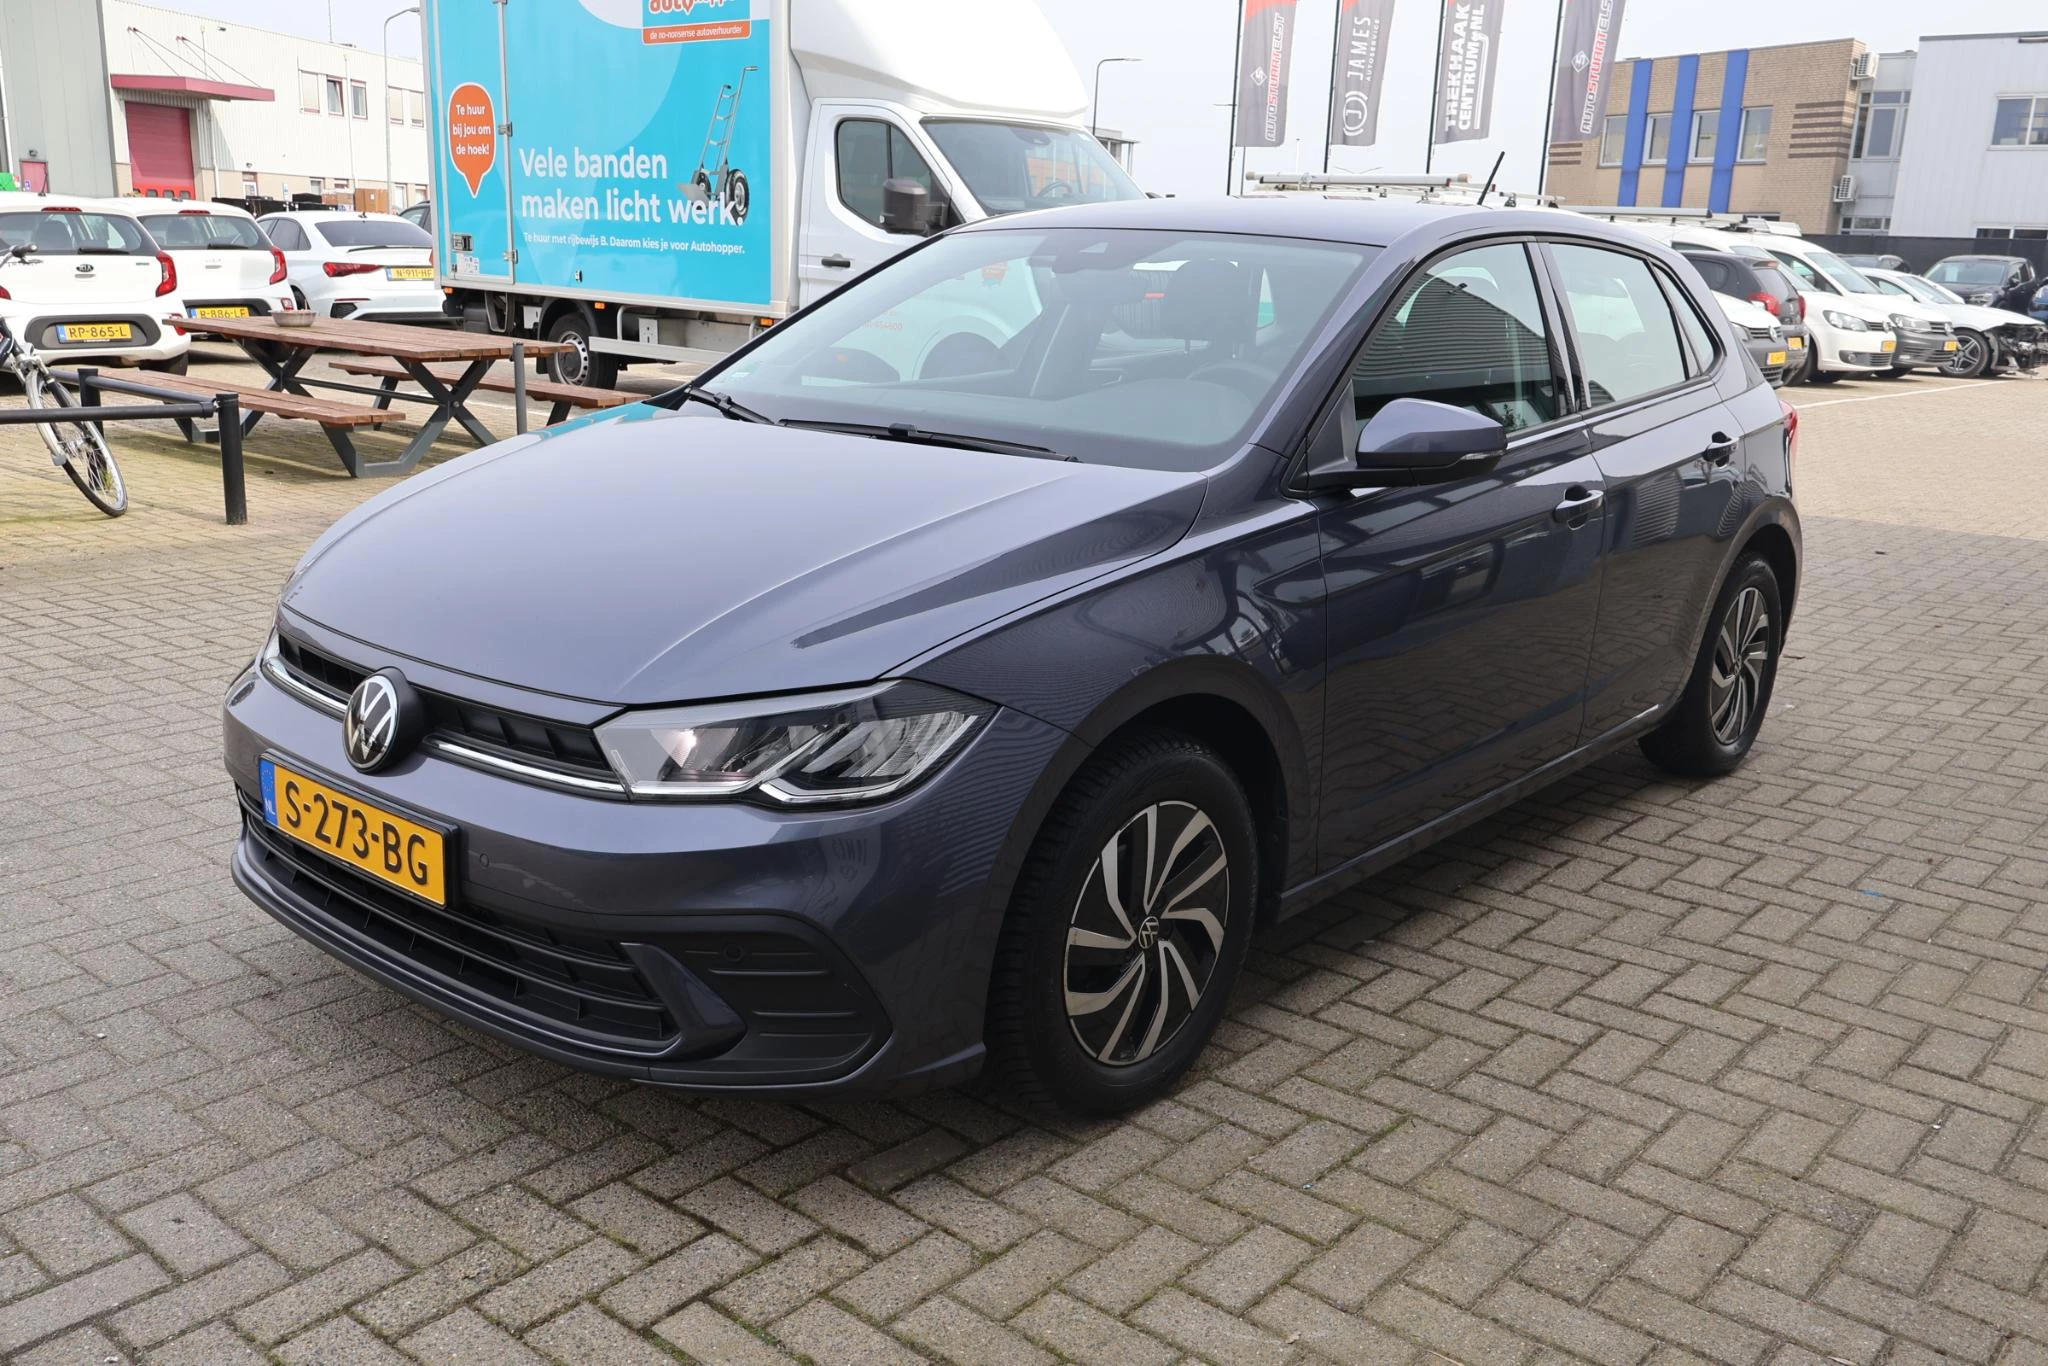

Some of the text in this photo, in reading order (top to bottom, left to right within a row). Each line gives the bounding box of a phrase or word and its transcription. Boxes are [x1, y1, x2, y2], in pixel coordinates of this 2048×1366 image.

[650, 25, 742, 39] de no-nonsense autoverhuurder
[1347, 16, 1371, 80] JAMES
[1366, 18, 1380, 81] AUTOSERVICE
[1265, 12, 1285, 141] AUTOSTUARTELST
[1445, 3, 1471, 131] TREKHAAK
[456, 104, 485, 115] Te huur
[453, 124, 491, 138] bij jou om
[456, 144, 490, 155] de hoek!
[519, 146, 668, 180] Vele banden
[521, 187, 744, 226] maken licht werk.
[523, 232, 745, 255] Te huur met rijbewijs B. Daarom kies je voor Autohopper.
[69, 326, 126, 338] RP-865-L
[264, 797, 276, 816] NL
[285, 780, 428, 886] S-273-BG
